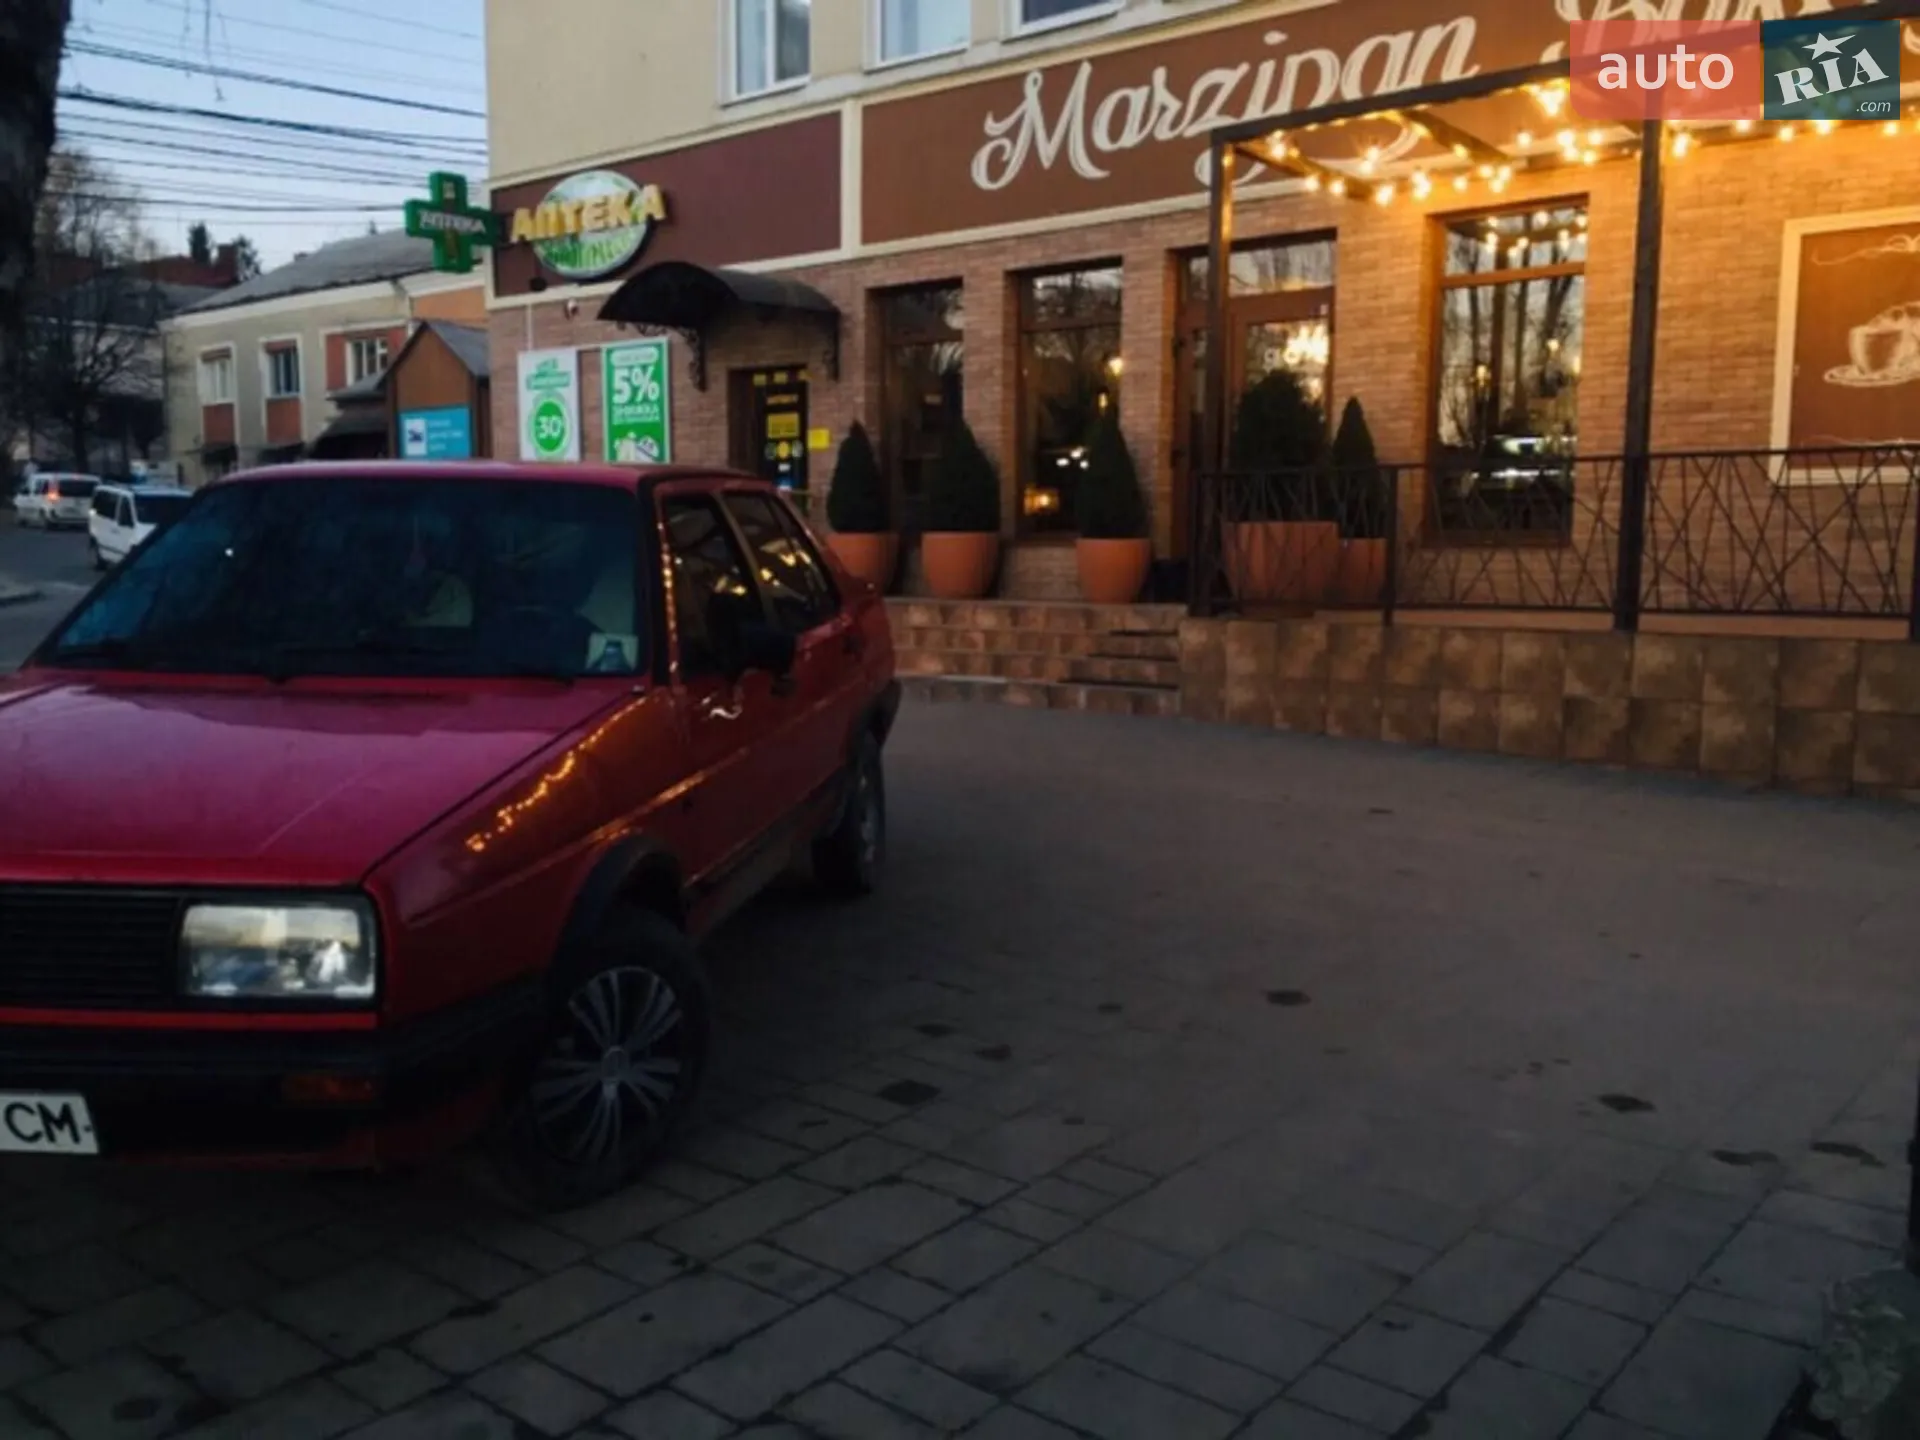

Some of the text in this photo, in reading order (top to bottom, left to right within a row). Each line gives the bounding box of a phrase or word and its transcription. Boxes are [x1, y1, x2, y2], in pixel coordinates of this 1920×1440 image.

[971, 16, 1481, 190] Marzipan
[510, 184, 666, 244] АПТЕКА
[612, 365, 660, 404] 5%
[537, 416, 562, 438] 30
